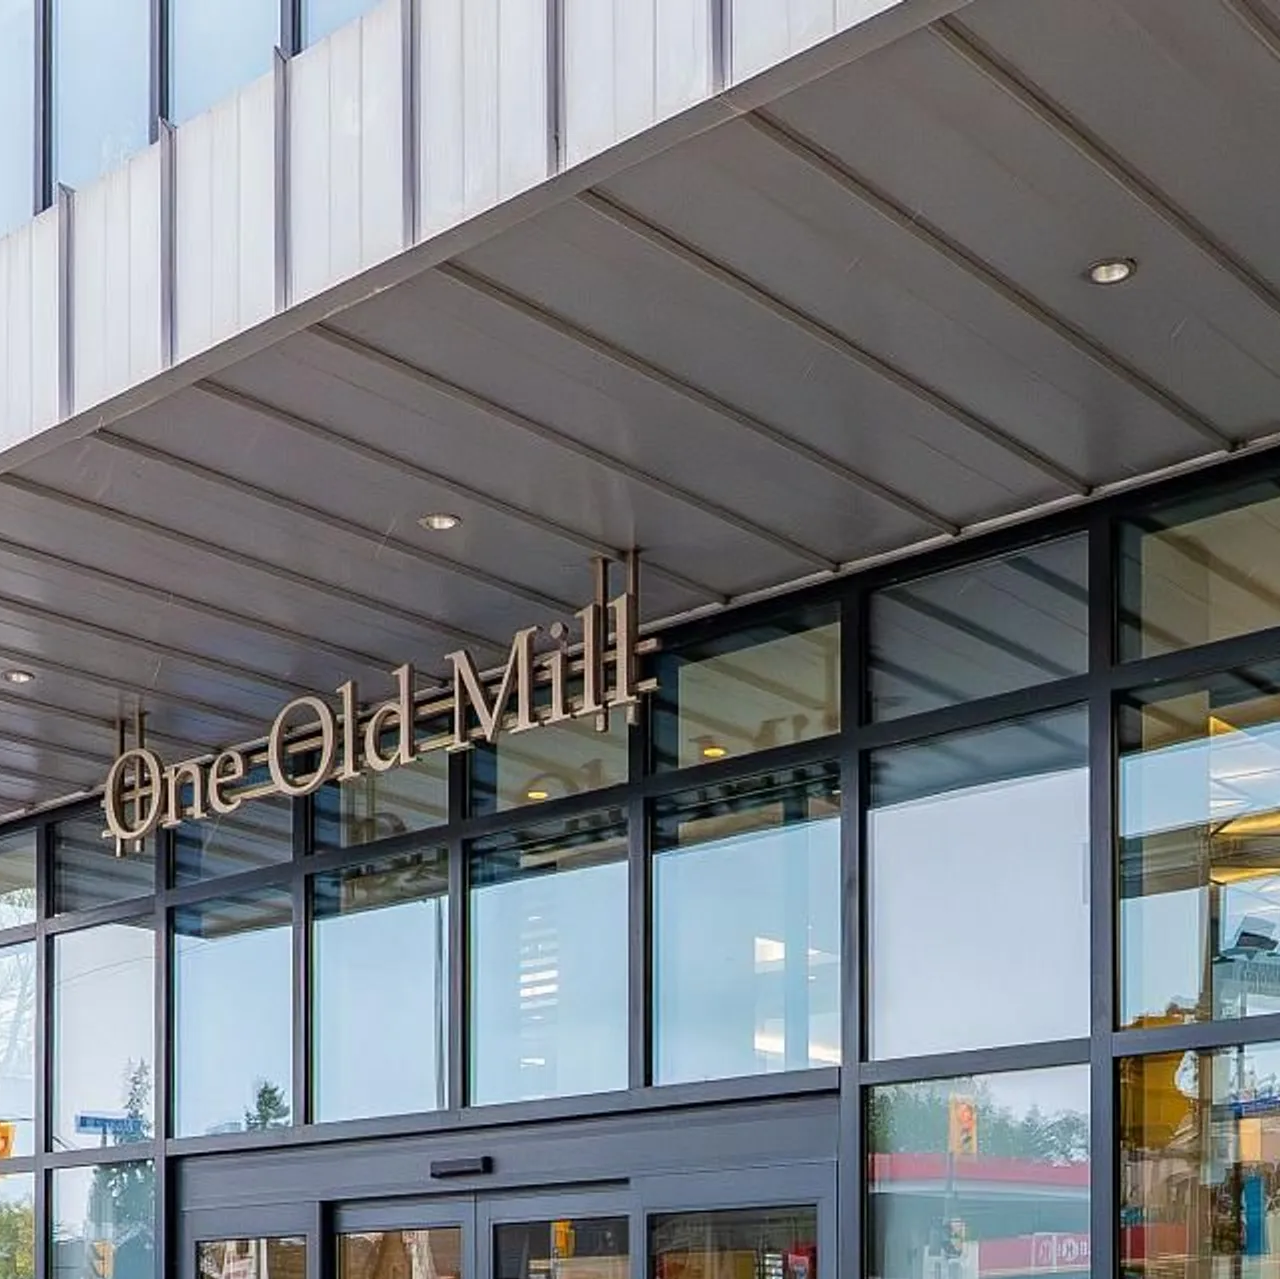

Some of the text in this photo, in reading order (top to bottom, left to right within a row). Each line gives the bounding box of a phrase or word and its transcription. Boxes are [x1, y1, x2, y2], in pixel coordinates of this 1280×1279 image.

[104, 592, 641, 840] One Old Mill
